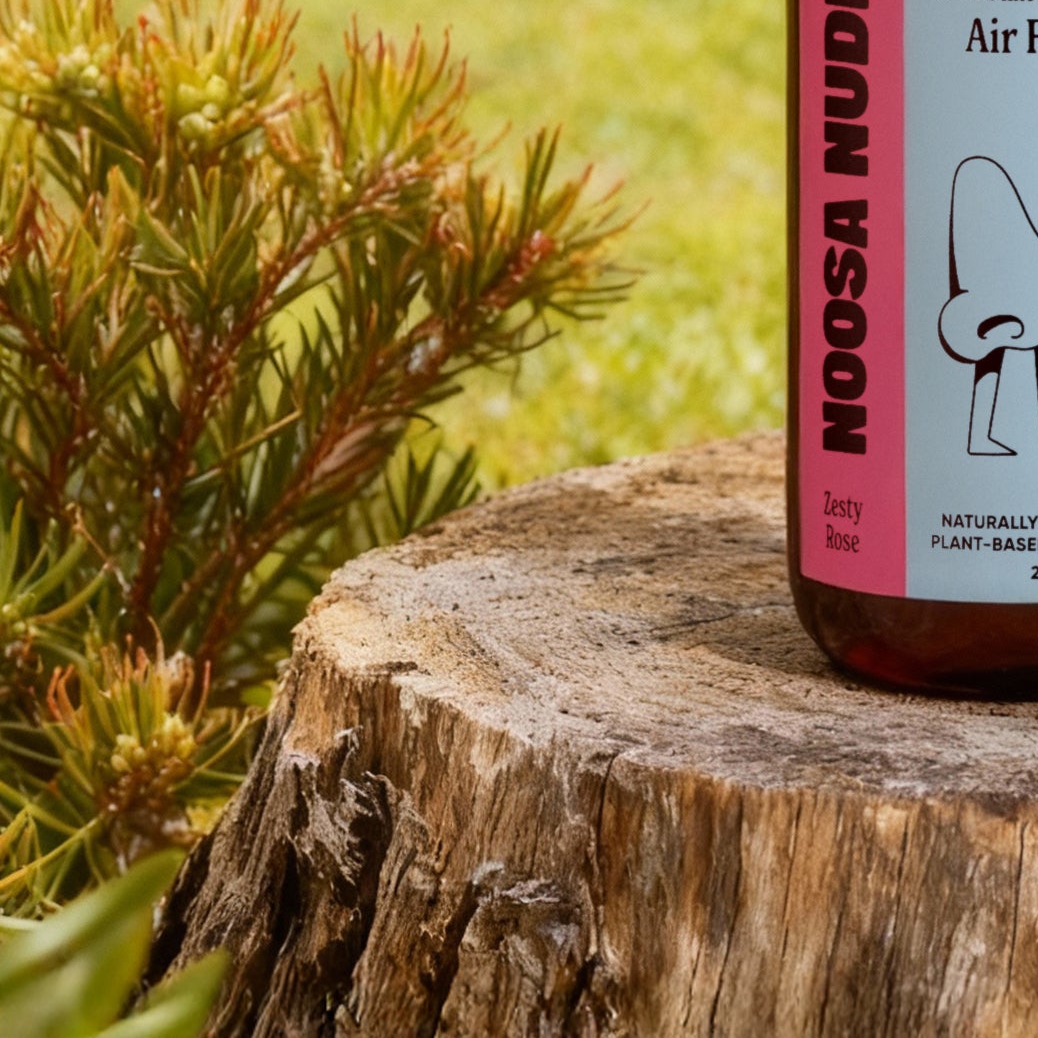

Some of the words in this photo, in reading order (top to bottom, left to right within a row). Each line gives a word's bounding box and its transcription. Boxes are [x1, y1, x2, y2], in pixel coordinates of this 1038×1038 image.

[966, 18, 1017, 53] Air
[822, 200, 868, 455] NOOSA
[824, 491, 862, 523] Zesty
[942, 514, 1038, 529] NATURALLY
[826, 523, 859, 553] Rose
